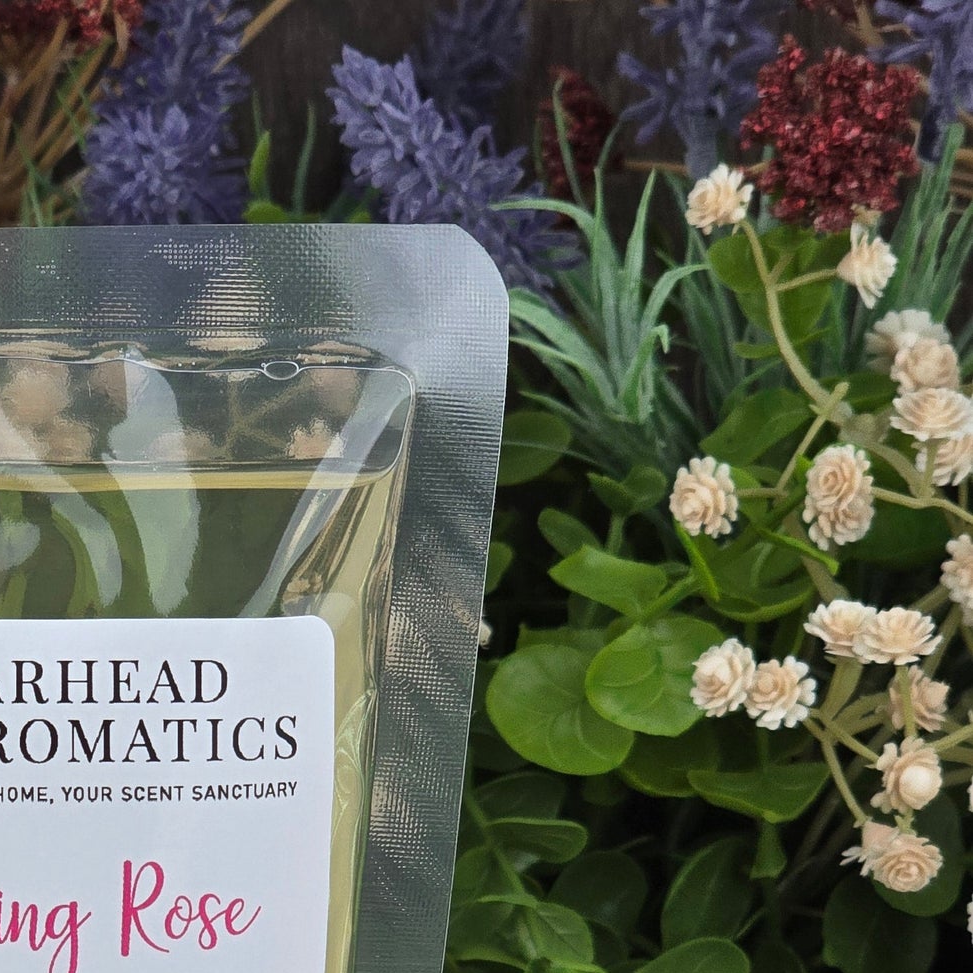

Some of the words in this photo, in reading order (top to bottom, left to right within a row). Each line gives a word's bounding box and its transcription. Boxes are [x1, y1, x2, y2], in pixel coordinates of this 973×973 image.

[60, 786, 113, 804] YOUR
[121, 785, 185, 803] SCENT
[191, 781, 298, 802] SANCTUARY
[120, 859, 262, 958] Rose
